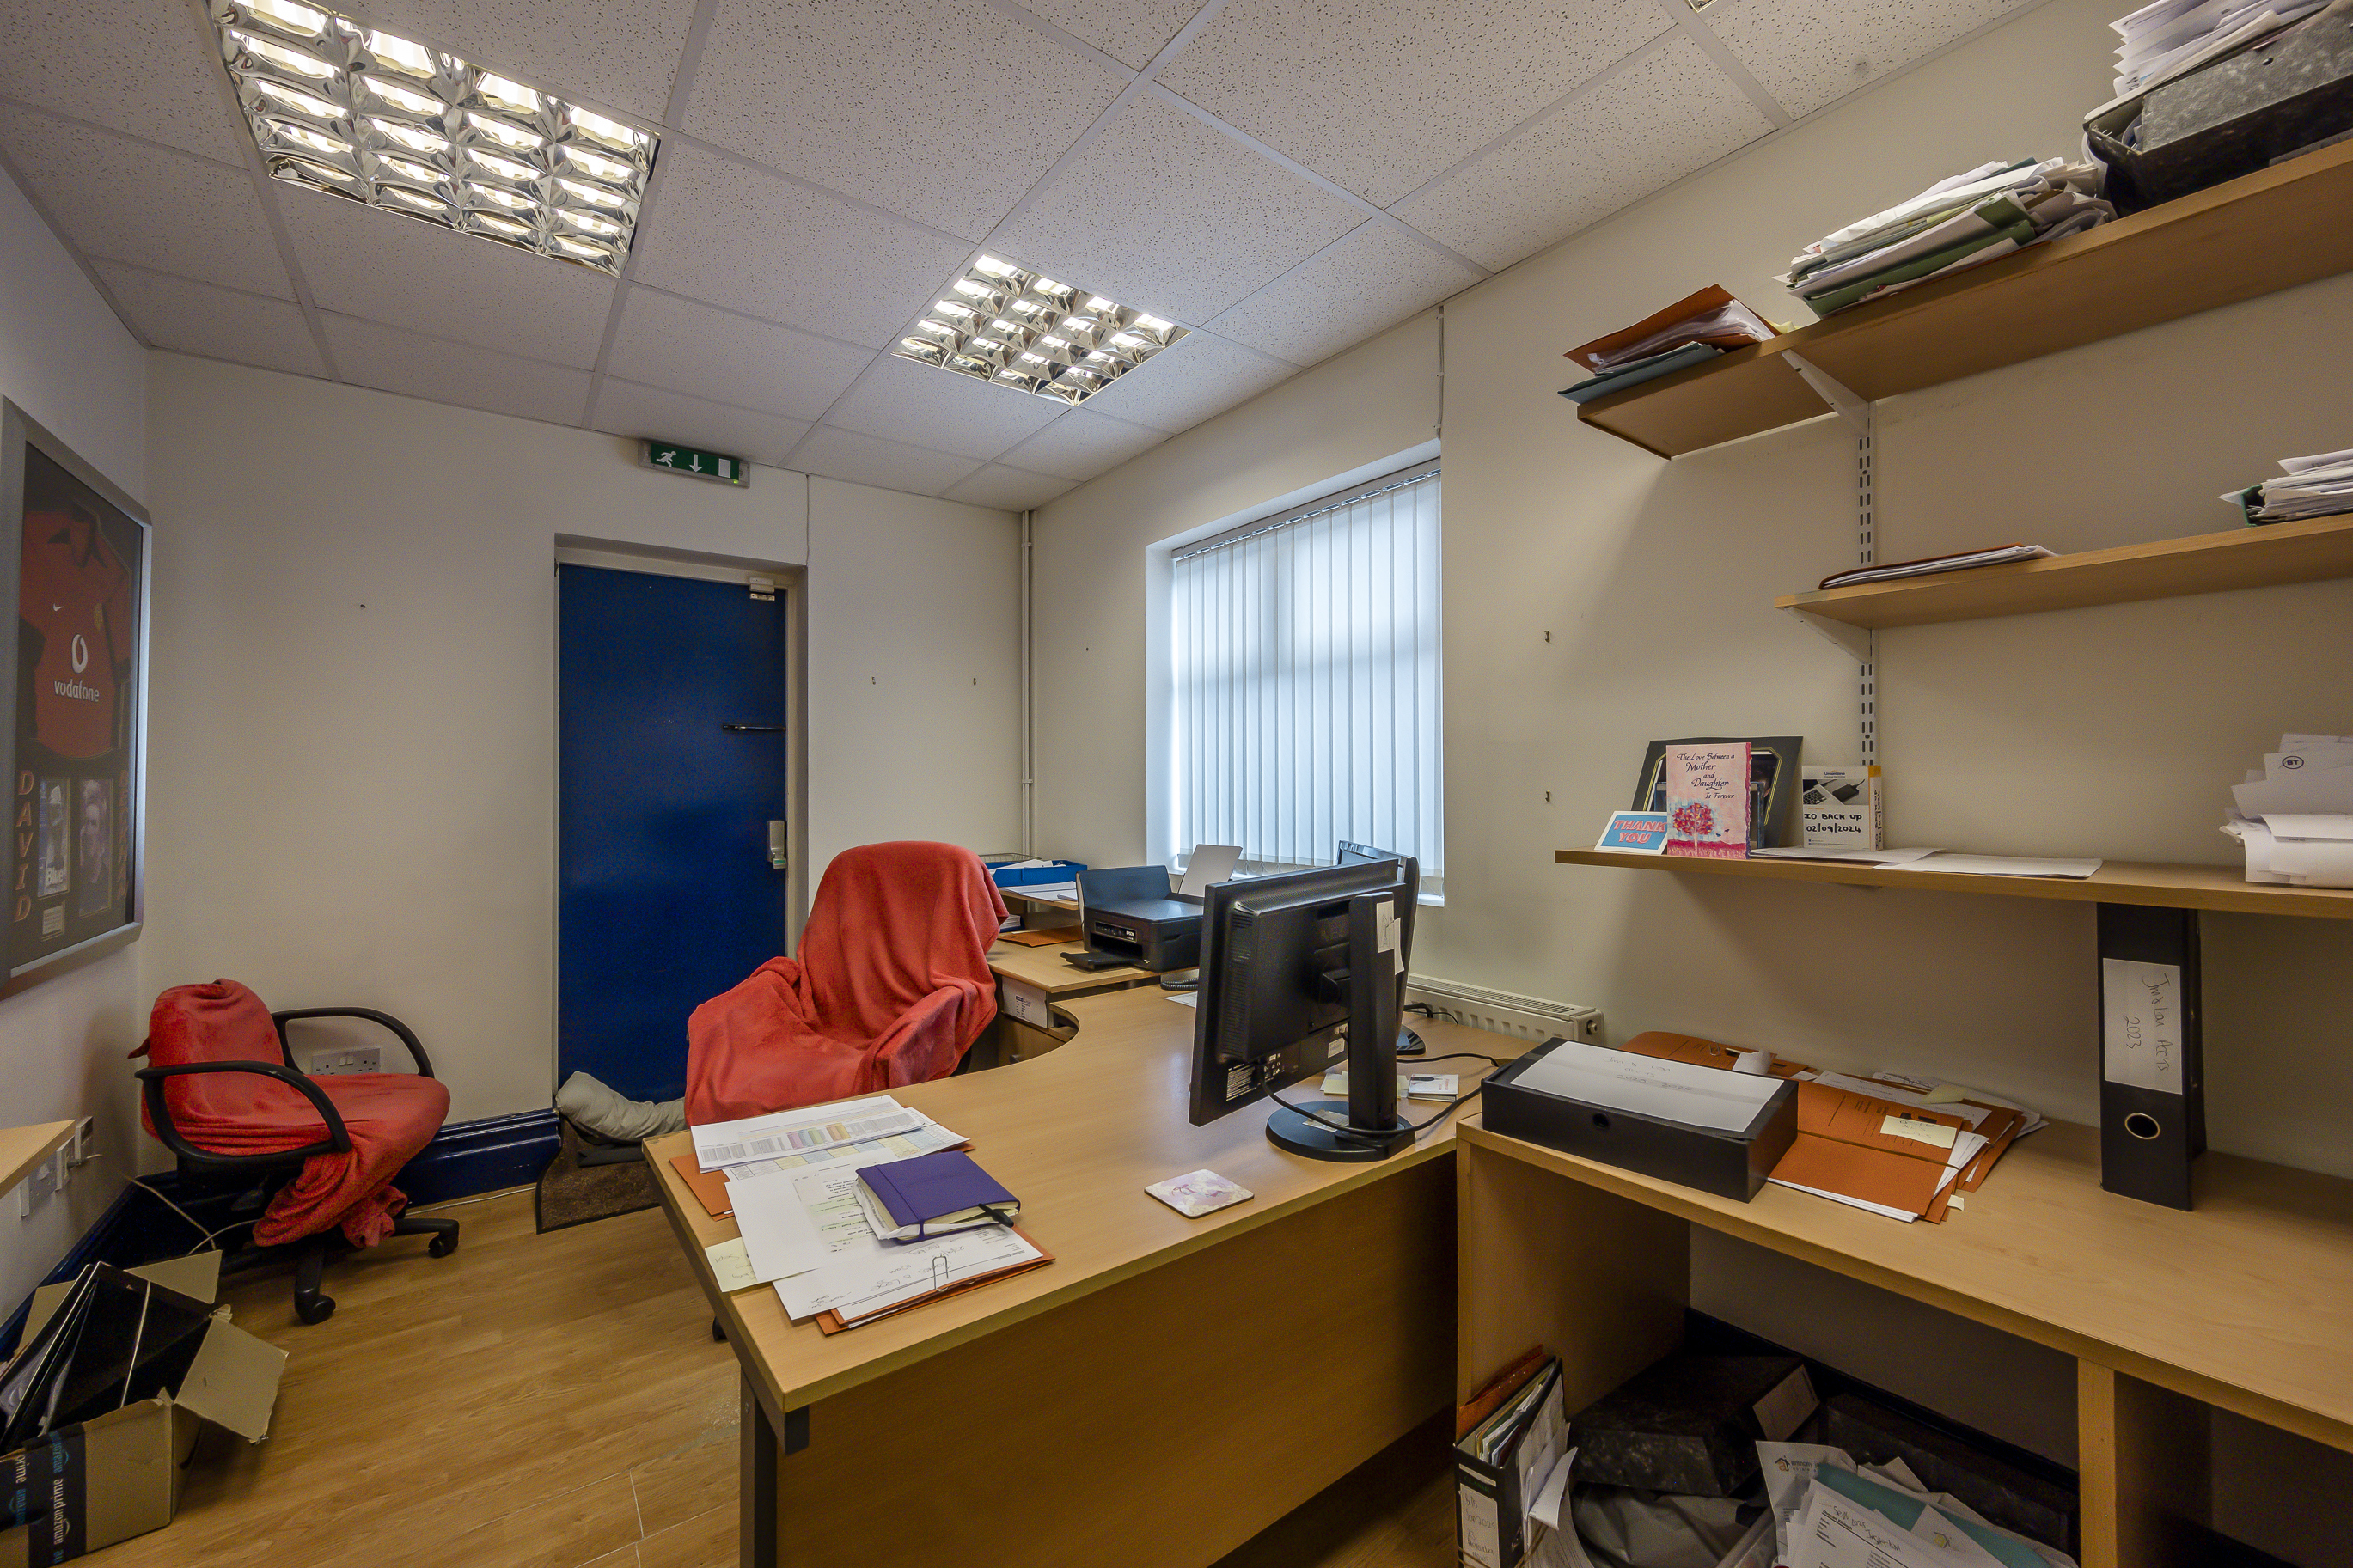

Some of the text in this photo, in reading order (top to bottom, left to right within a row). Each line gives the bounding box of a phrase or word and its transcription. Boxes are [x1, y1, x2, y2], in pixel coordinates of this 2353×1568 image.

[54, 679, 101, 703] vodafone
[1686, 760, 1717, 772] Mother
[1690, 753, 1705, 761] Love
[1691, 778, 1729, 790] Daughter
[1613, 820, 1667, 833] THANK
[15, 769, 35, 923] DAVID
[1618, 832, 1652, 844] YOU
[46, 866, 64, 885] Blue
[2123, 1016, 2142, 1050] 2023
[15, 1453, 29, 1484] prime
[51, 1478, 66, 1510] prime
[53, 1510, 65, 1545] amazon
